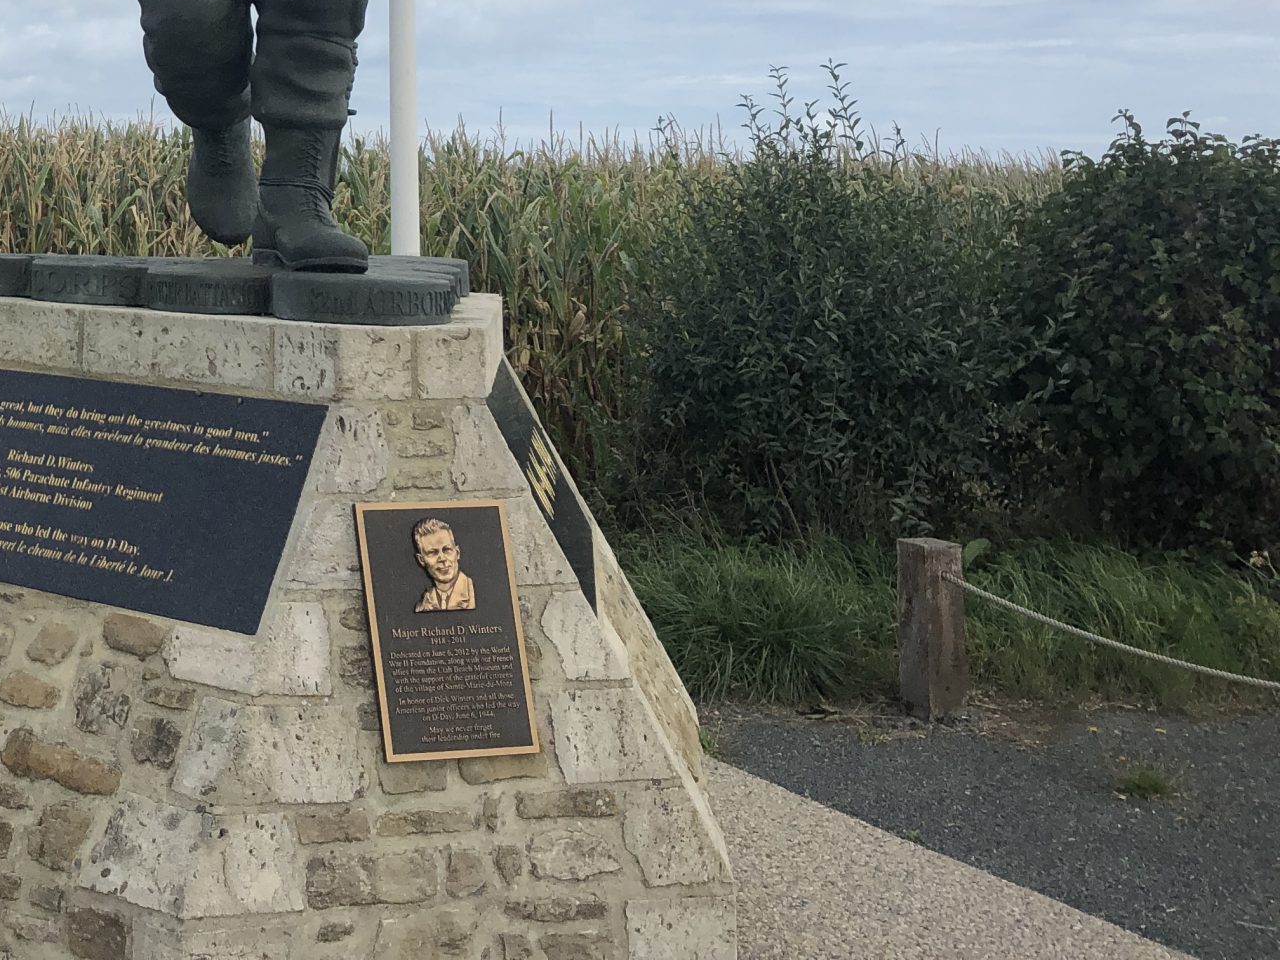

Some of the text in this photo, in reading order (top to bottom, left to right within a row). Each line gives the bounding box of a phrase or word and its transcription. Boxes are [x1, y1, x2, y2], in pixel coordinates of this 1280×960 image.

[0, 398, 25, 413] great,
[27, 401, 43, 415] but
[44, 403, 65, 420] they
[65, 406, 79, 419] do
[80, 408, 107, 425] bring
[107, 413, 124, 424] out
[126, 413, 143, 428] the
[143, 417, 192, 434] greatness
[192, 422, 205, 435] in
[205, 426, 233, 440] good
[5, 416, 46, 433] hommes,
[46, 422, 70, 436] mais
[70, 426, 93, 439] elles
[92, 428, 133, 445] révèlent
[133, 432, 145, 446] la
[143, 436, 194, 452] grandeur
[192, 441, 211, 455] des
[211, 442, 257, 462] hommes
[7, 448, 45, 466] Richard
[3, 466, 22, 480] 506
[21, 468, 71, 489] Parachute
[71, 476, 113, 497] Infantry
[114, 484, 164, 504] Regiment
[9, 484, 52, 505] Airborne
[52, 494, 93, 512] Division
[14, 521, 34, 536] who
[34, 524, 52, 539] led
[51, 527, 69, 542] the
[70, 533, 89, 549] way
[90, 536, 105, 549] on
[106, 537, 141, 558] D-Day.
[16, 539, 27, 554] le
[27, 542, 63, 561] chemin
[63, 549, 77, 563] de
[76, 551, 89, 566] la
[89, 554, 128, 573] Liberté
[126, 561, 138, 575] le
[136, 564, 165, 580] Jour
[162, 569, 174, 583] J.
[392, 628, 419, 640] Major
[420, 627, 455, 637] Richard
[468, 625, 503, 634] Winters
[390, 651, 421, 660] Dedicated
[454, 648, 470, 656] 2012
[448, 657, 465, 666] along
[453, 665, 473, 673] Beach
[421, 675, 445, 684] support
[414, 684, 436, 693] village
[407, 697, 425, 705] honor
[450, 695, 475, 703] Winters
[476, 693, 488, 701] and
[395, 706, 426, 714] American
[426, 705, 445, 714] junior
[445, 703, 471, 711] officers
[471, 702, 485, 710] who
[507, 701, 520, 709] way
[429, 726, 444, 734] May
[474, 723, 493, 732] forget
